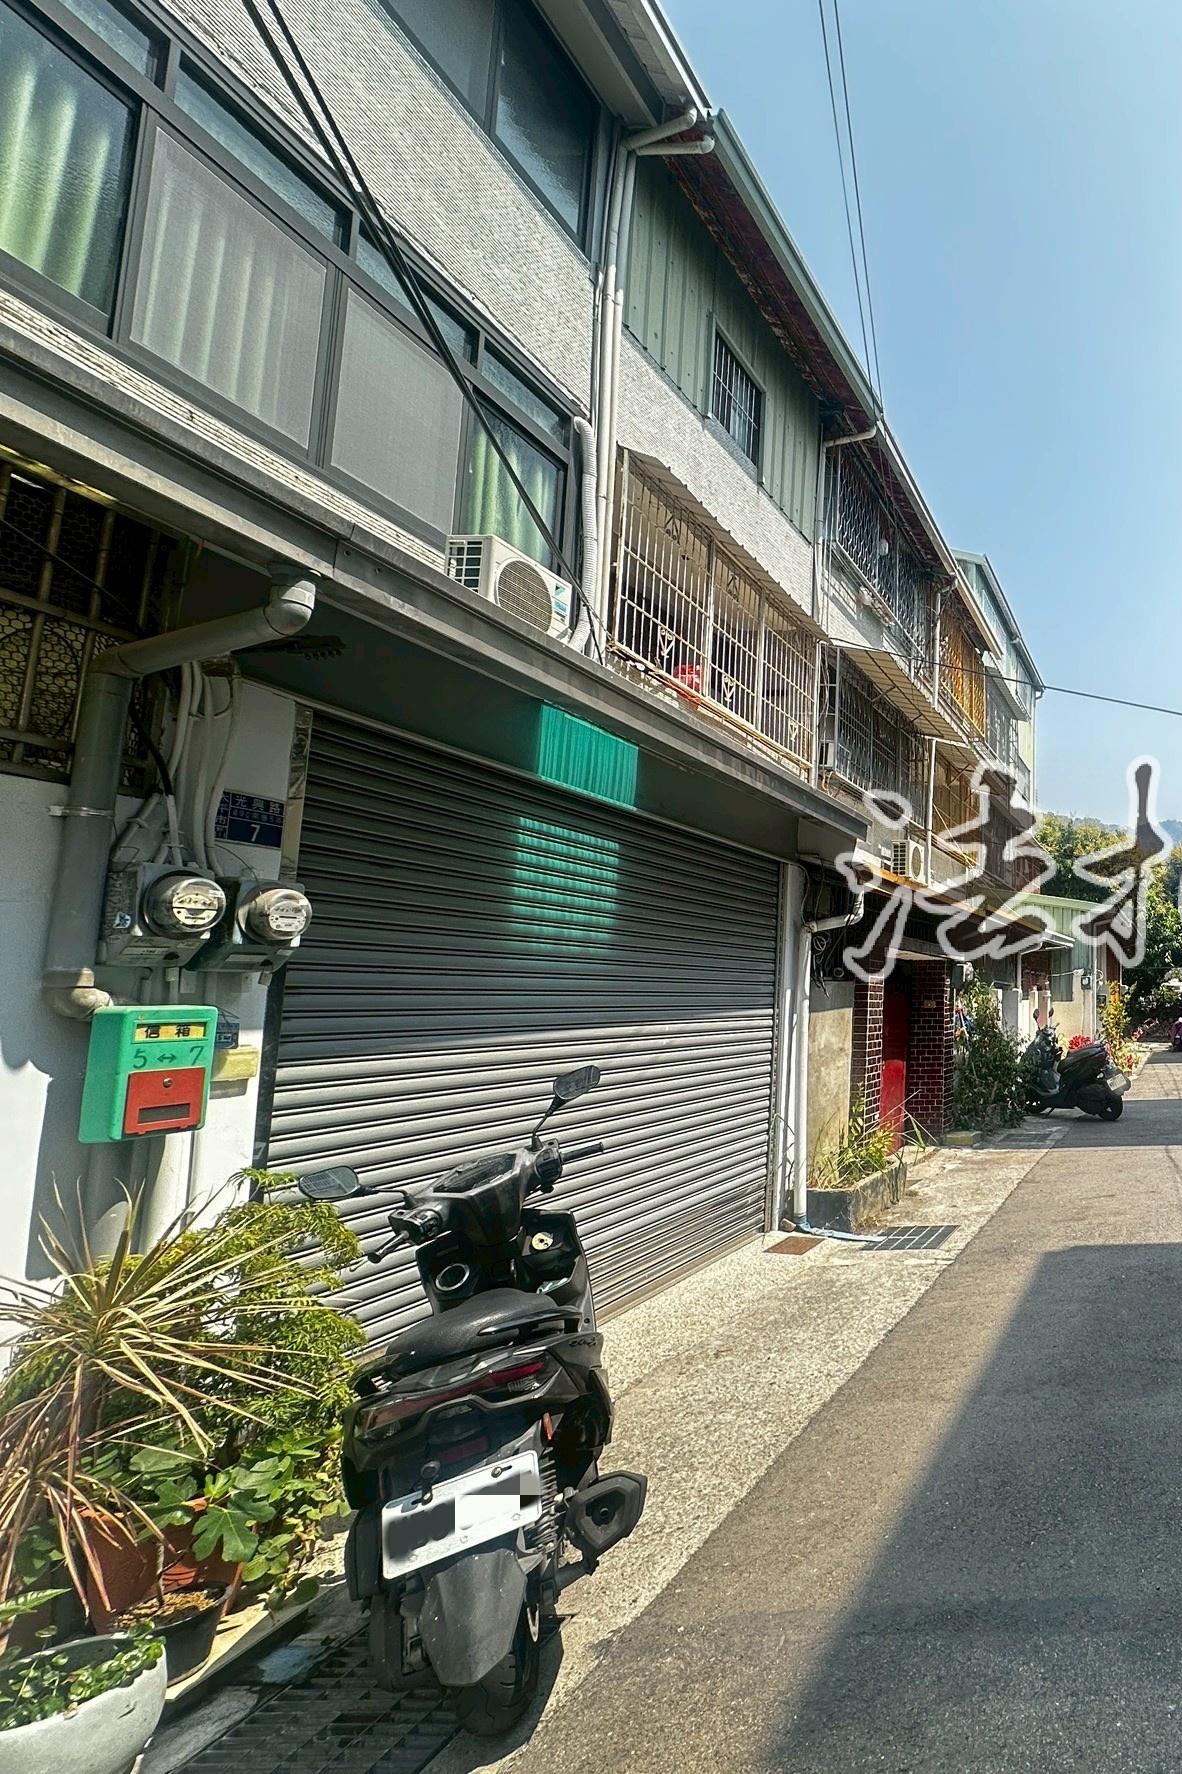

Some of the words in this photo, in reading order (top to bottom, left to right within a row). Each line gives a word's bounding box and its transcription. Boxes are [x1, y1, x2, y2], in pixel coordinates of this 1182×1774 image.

[250, 823, 261, 842] 7
[144, 1024, 191, 1039] 信箱
[132, 1048, 148, 1069] 5
[189, 1045, 204, 1066] 7
